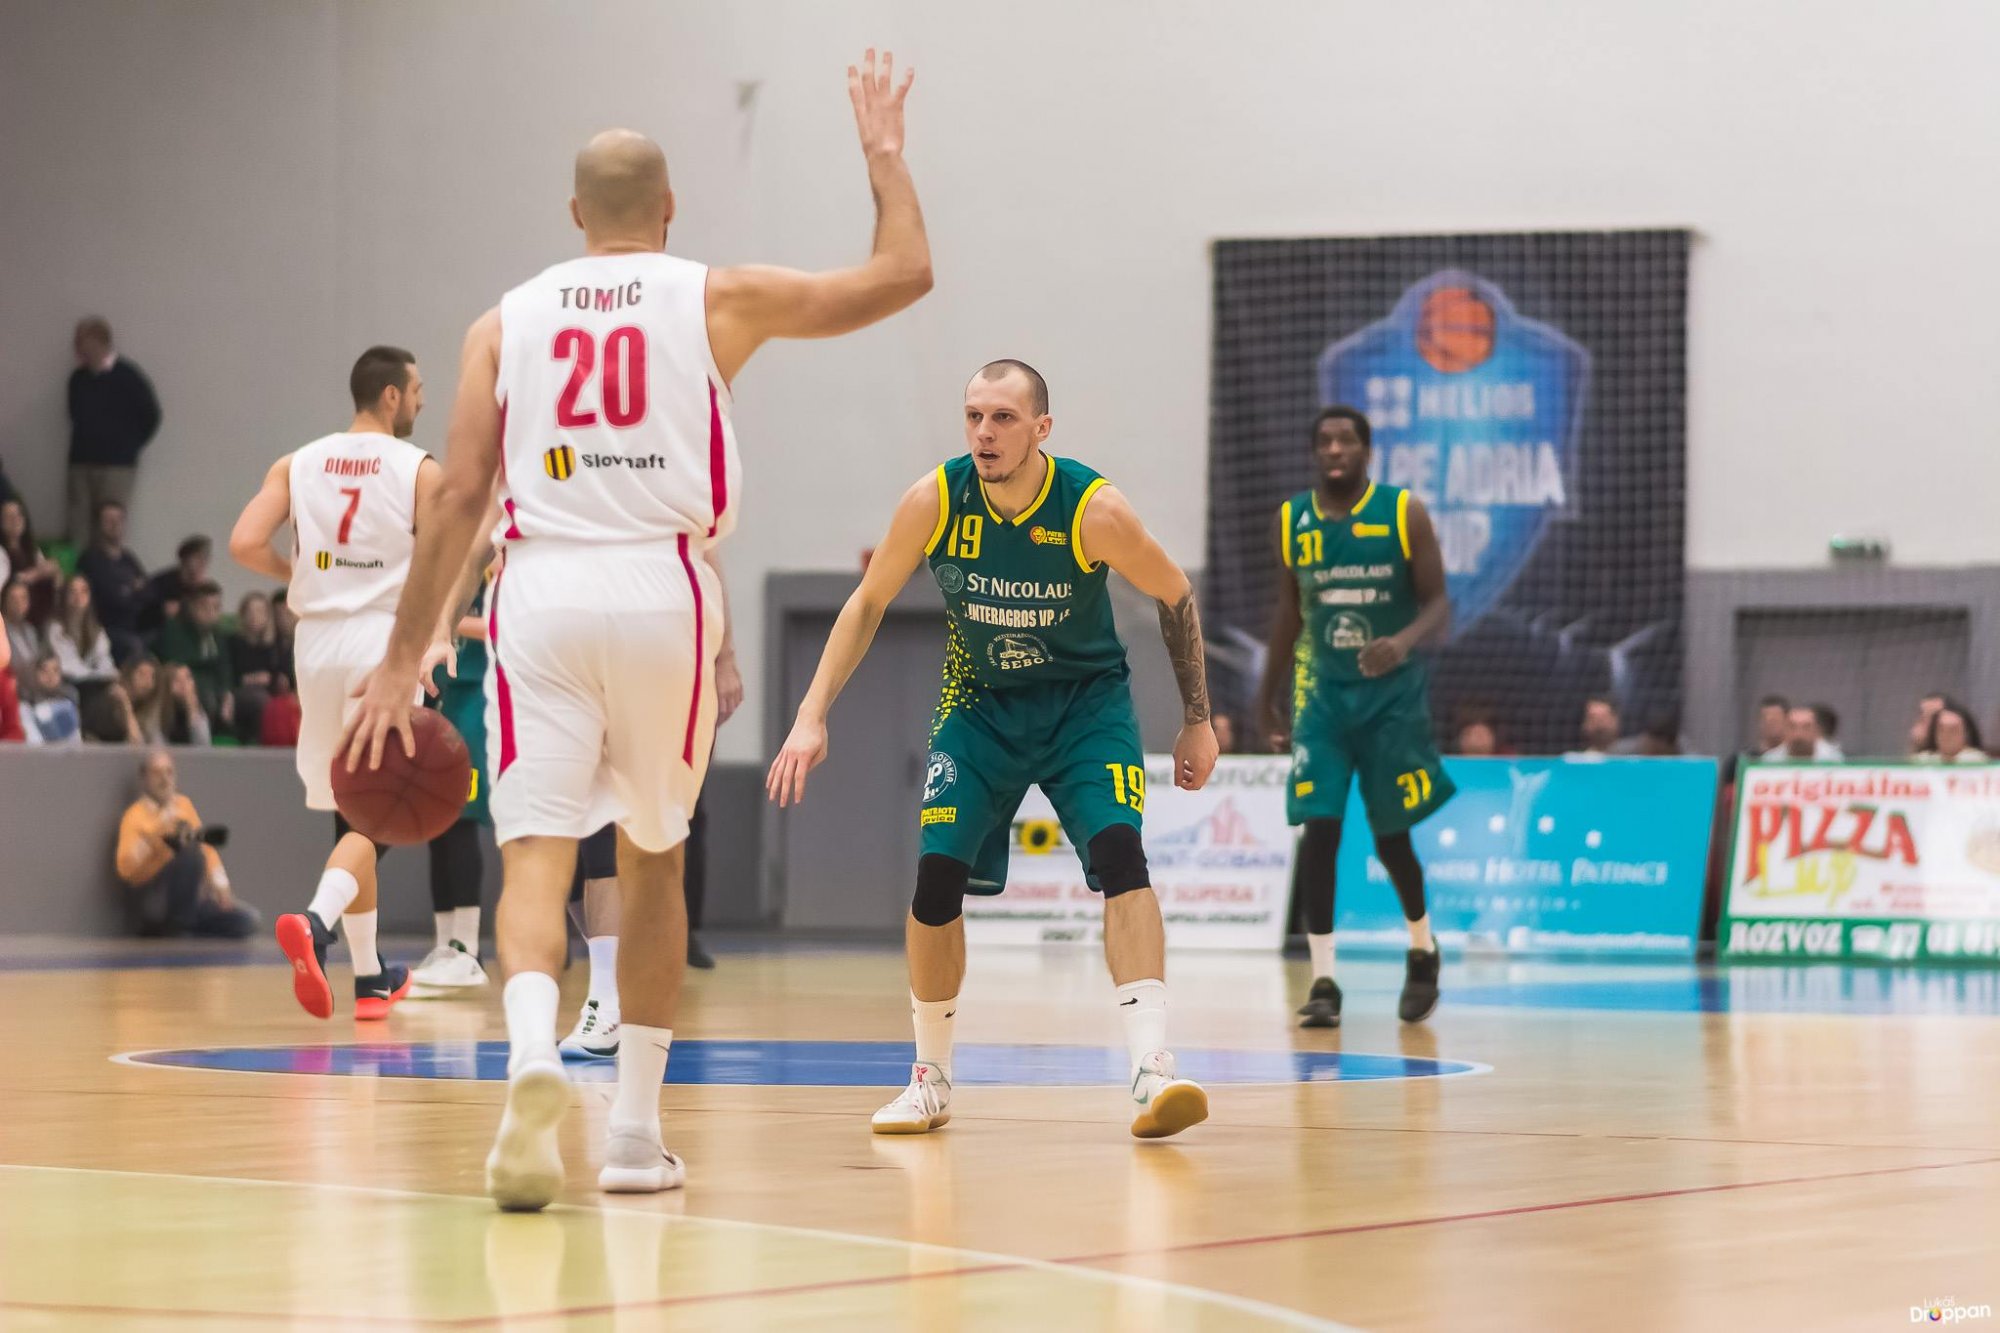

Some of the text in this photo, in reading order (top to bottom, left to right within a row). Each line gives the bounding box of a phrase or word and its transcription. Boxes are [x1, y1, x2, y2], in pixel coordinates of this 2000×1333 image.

[560, 277, 642, 312] TOMIĆ
[552, 326, 648, 429] 20
[1445, 441, 1566, 504] ADRIA
[338, 488, 360, 545] 7
[947, 514, 983, 559] 19
[1297, 529, 1323, 566] 31
[1430, 511, 1491, 576] UP
[1001, 658, 1045, 670] ŠEBO
[1106, 764, 1144, 814] 19
[1397, 769, 1432, 809] 31
[1754, 774, 1931, 801] originálna
[1744, 804, 1920, 884] PIZZA
[1730, 921, 1843, 954] ROZVOZ
